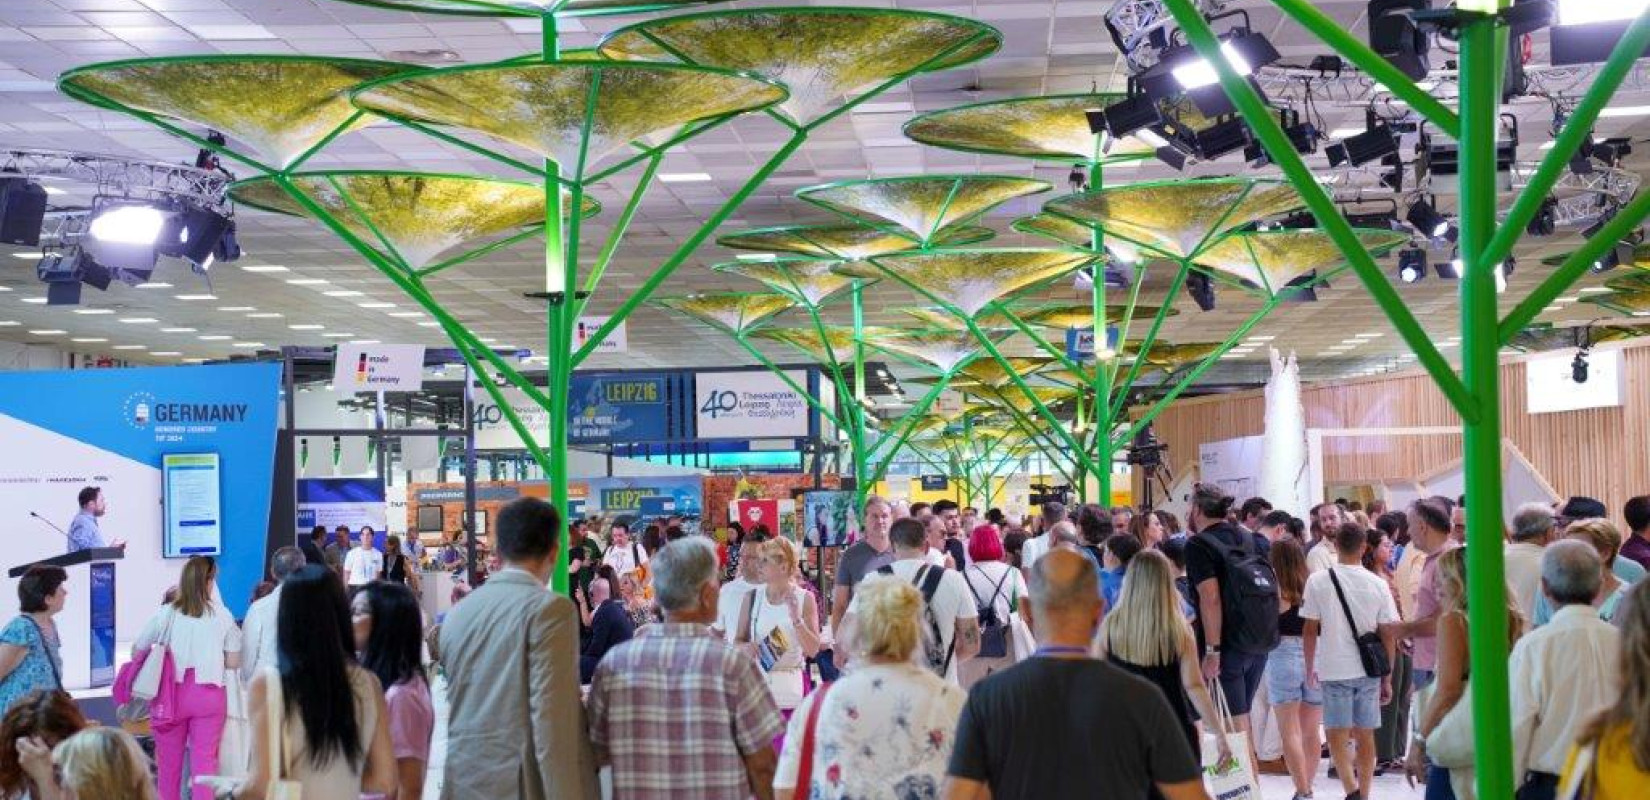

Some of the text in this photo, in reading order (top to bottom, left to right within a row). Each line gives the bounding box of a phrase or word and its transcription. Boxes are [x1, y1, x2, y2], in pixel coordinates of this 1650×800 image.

[607, 382, 657, 401] LEIPZIG
[155, 402, 248, 422] GERMANY
[700, 389, 738, 418] 40
